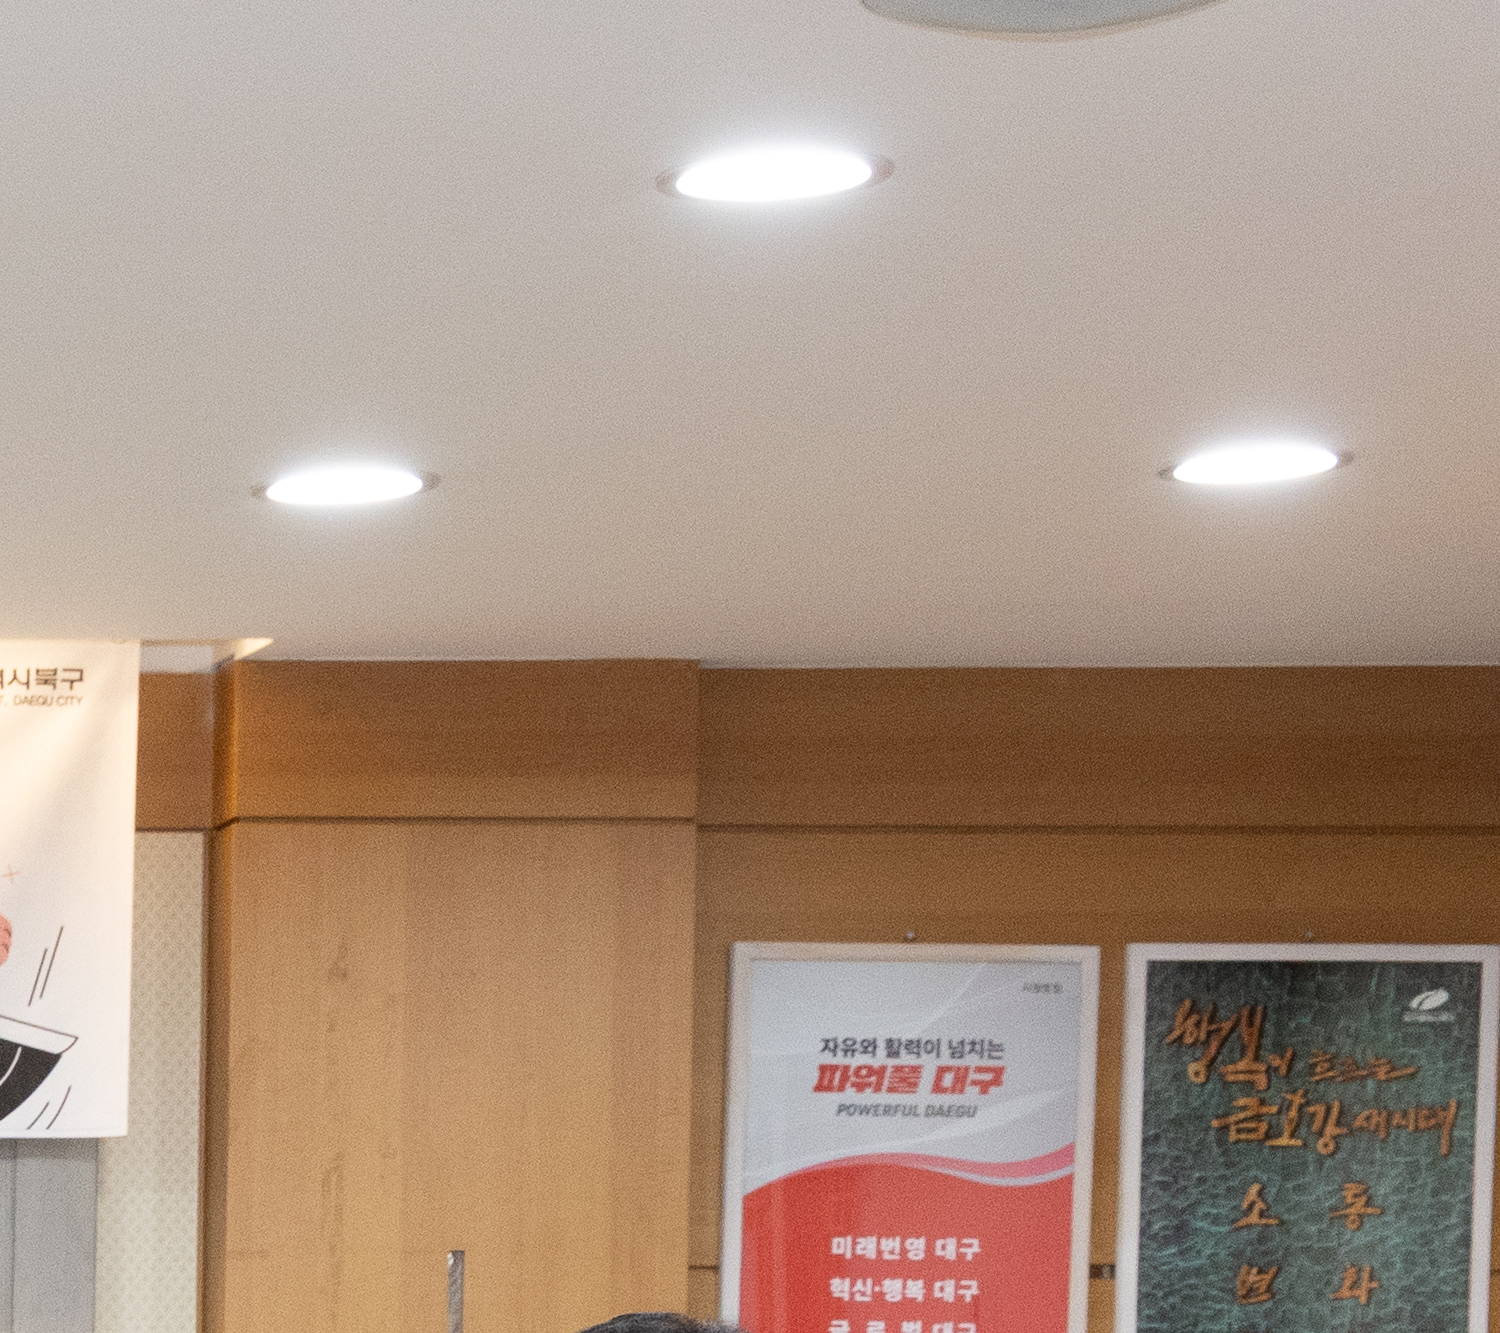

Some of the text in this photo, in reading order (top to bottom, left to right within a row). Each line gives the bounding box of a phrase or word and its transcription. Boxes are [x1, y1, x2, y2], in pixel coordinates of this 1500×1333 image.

[12, 695, 54, 708] DAEGU
[56, 695, 84, 708] CITY
[819, 1037, 1005, 1060] 자유와 활력이 넘치는
[812, 1063, 1006, 1095] 파워풀 대구
[835, 1103, 979, 1119] POWERFUL DAEGU
[831, 1235, 982, 1261] 미래번영 대구
[933, 1278, 980, 1303] 대구
